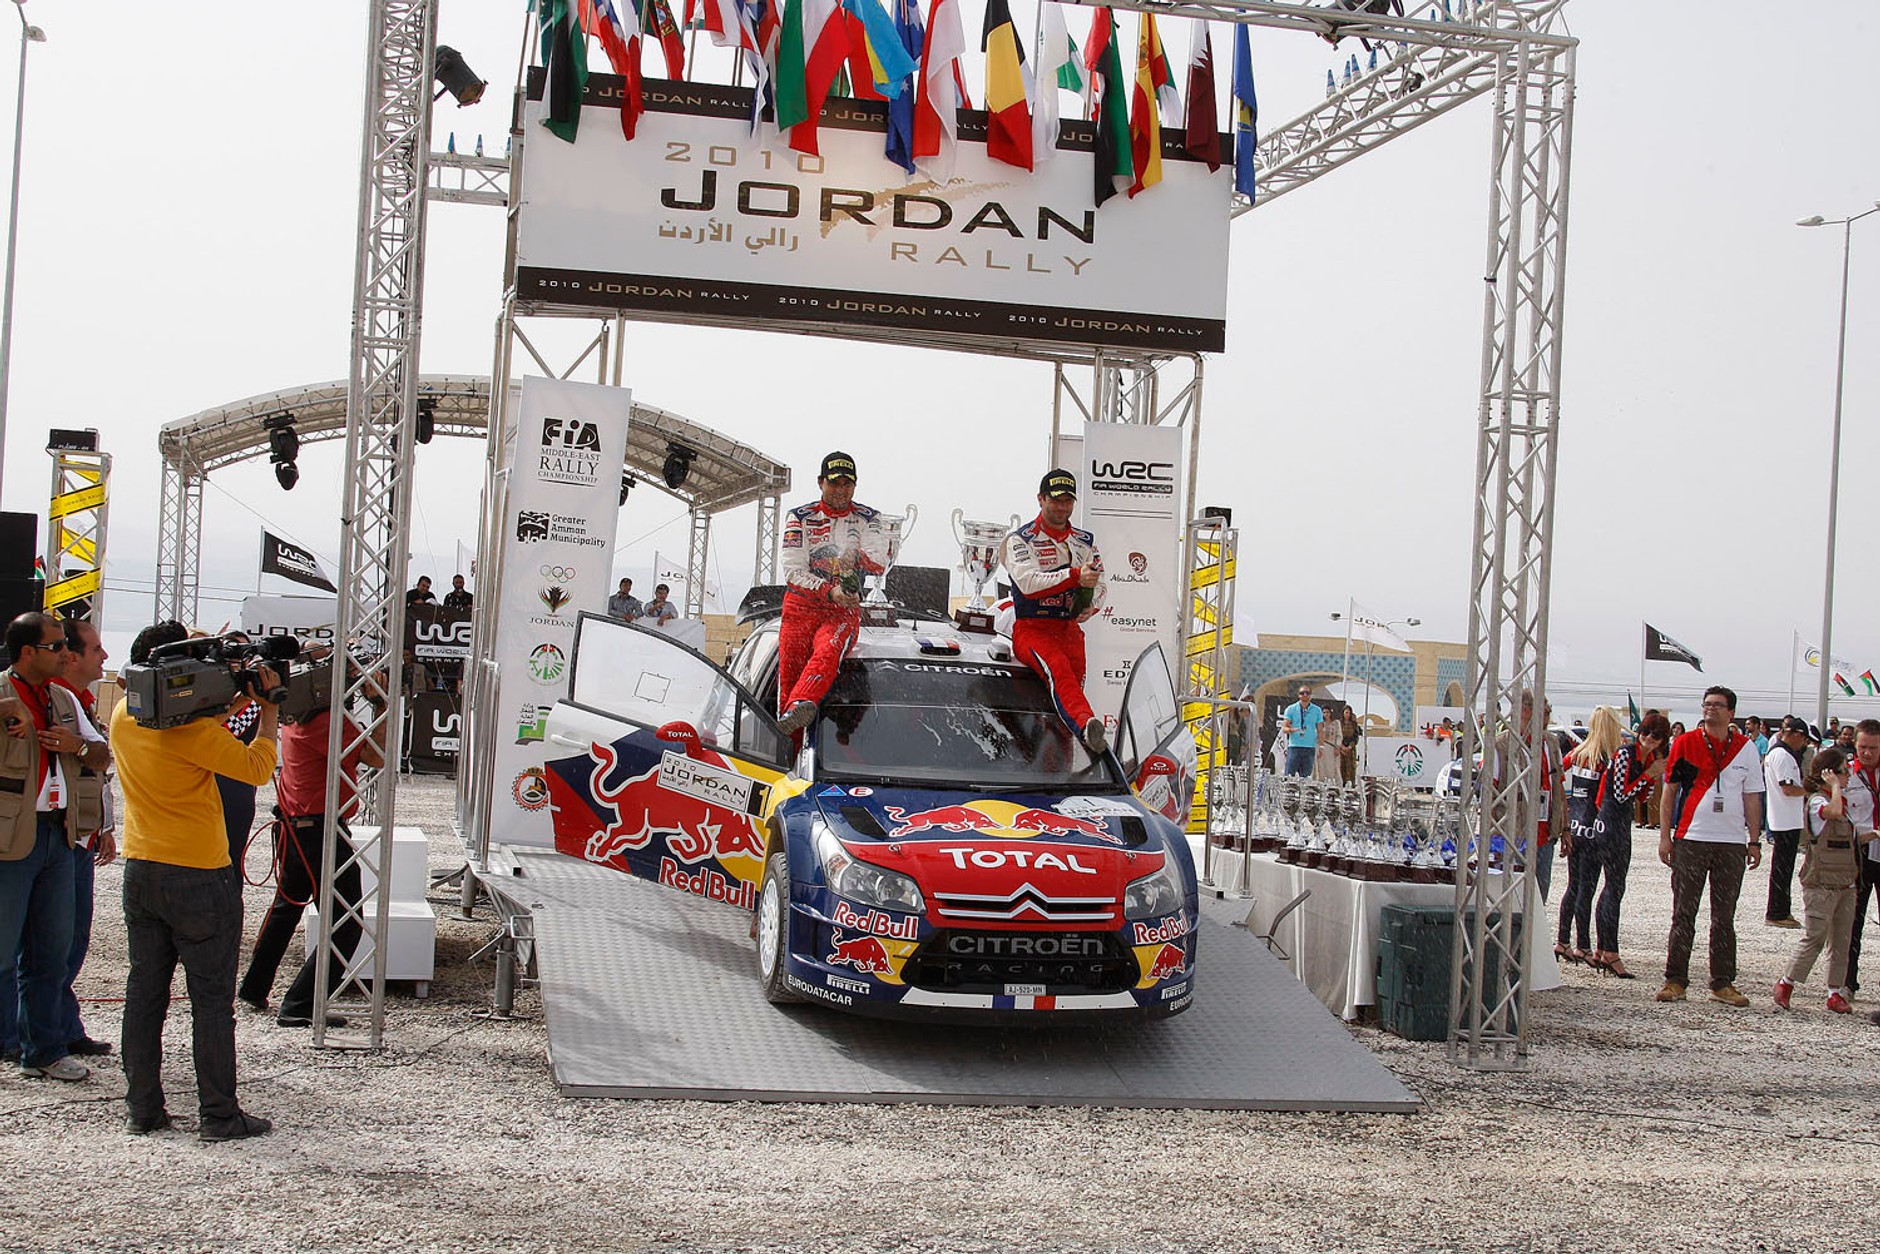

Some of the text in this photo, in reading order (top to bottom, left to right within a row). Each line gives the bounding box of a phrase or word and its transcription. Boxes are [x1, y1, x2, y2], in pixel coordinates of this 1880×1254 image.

[710, 98, 750, 109] RALL
[835, 110, 885, 124] JOR
[665, 141, 825, 174] 2010
[660, 169, 1096, 245] JORDAN
[658, 216, 800, 255] رالي الأردن
[890, 241, 1093, 276] RALLY
[537, 278, 752, 301] 2010 JORDAN RALLY
[778, 296, 982, 319] 2010 JORDAN RALLY
[1008, 313, 1205, 336] 2010 JORDAN RALLY
[539, 456, 600, 476] RALLY
[1091, 459, 1174, 481] WRC
[537, 471, 599, 484] CHAMPIONSHIP
[551, 514, 587, 526] Greater
[551, 524, 588, 536] Amman
[550, 533, 607, 549] Municipality
[528, 616, 576, 629] JORDAN
[666, 730, 694, 738] TOTAL
[665, 757, 698, 772] 2010
[664, 765, 747, 799] JORDAN
[853, 787, 868, 796] E
[704, 788, 745, 807] RALLY
[758, 785, 770, 818] 1
[939, 848, 1098, 875] TOTAL
[658, 856, 756, 912] Red Bull
[833, 900, 920, 940] Red Bull
[1133, 916, 1169, 944] Red
[788, 974, 853, 1006] EURODATACAR
[826, 974, 871, 995] PIRELLI
